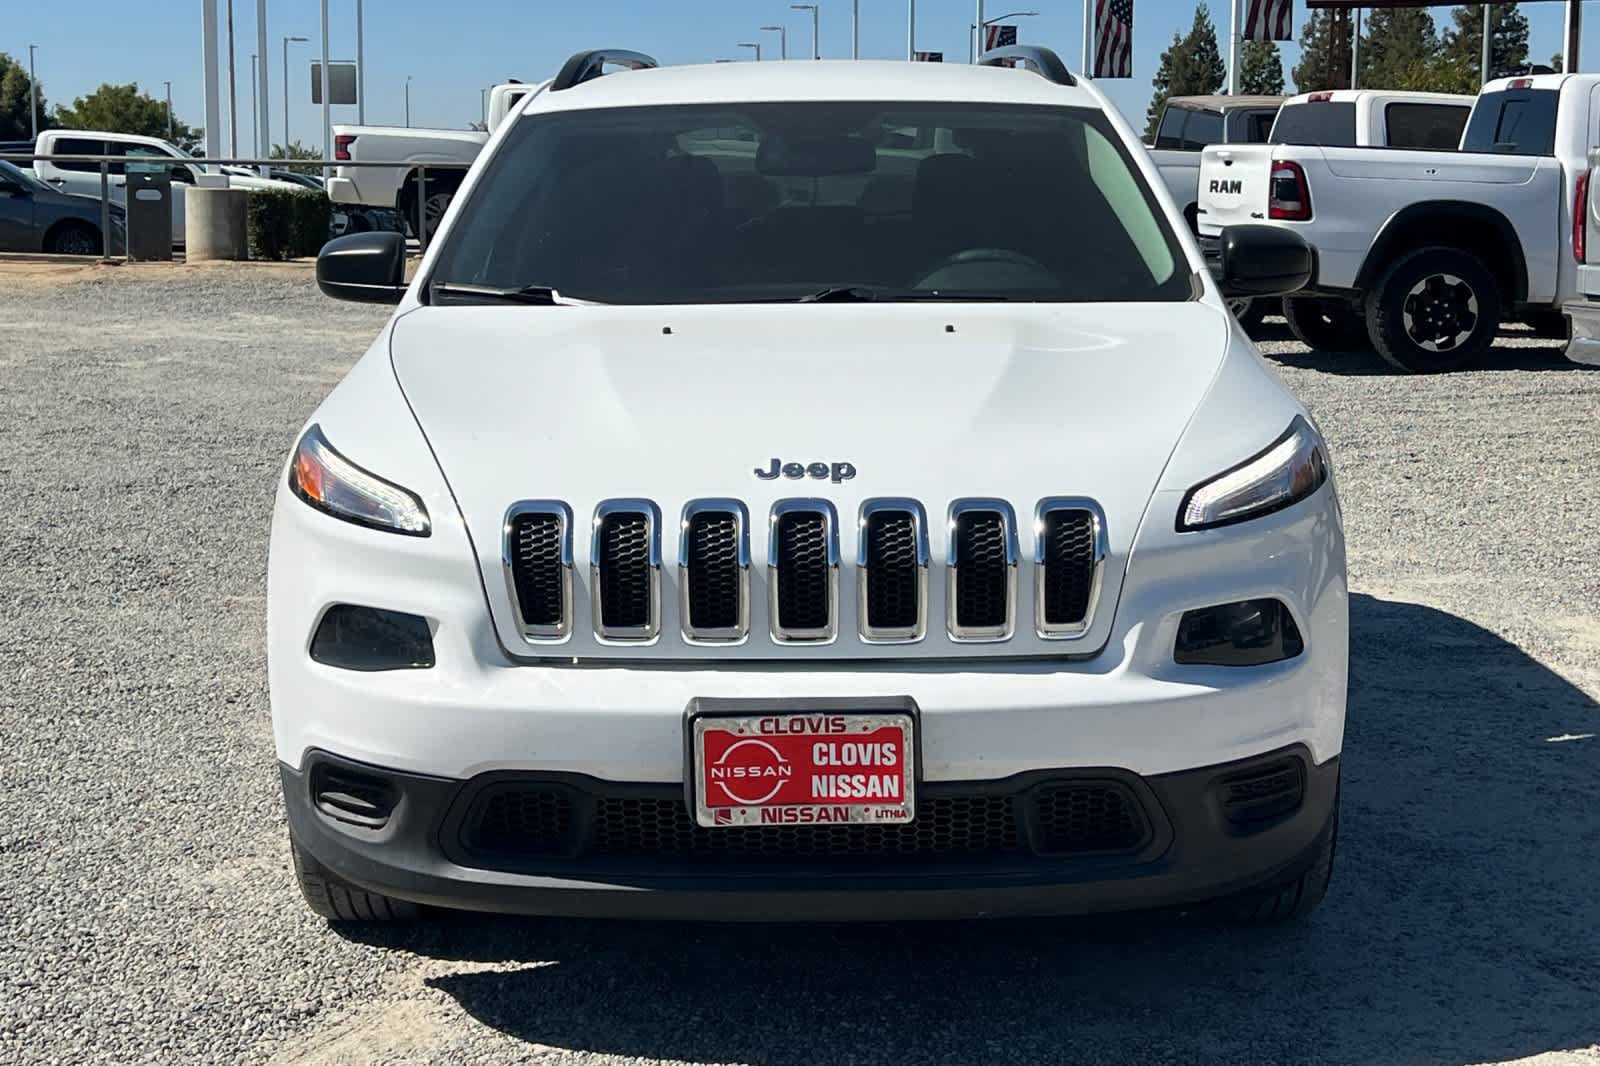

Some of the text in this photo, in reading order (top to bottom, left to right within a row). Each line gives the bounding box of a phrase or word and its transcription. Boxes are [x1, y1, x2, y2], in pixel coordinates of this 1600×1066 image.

[1210, 180, 1242, 194] RAM
[754, 458, 856, 484] Jeep
[760, 717, 847, 734] CLOVIS
[812, 742, 897, 766] CLOVIS
[711, 765, 792, 778] NISSAN
[812, 775, 899, 798] NISSAN
[761, 807, 849, 824] NISSAN
[875, 809, 907, 819] LITHIA
